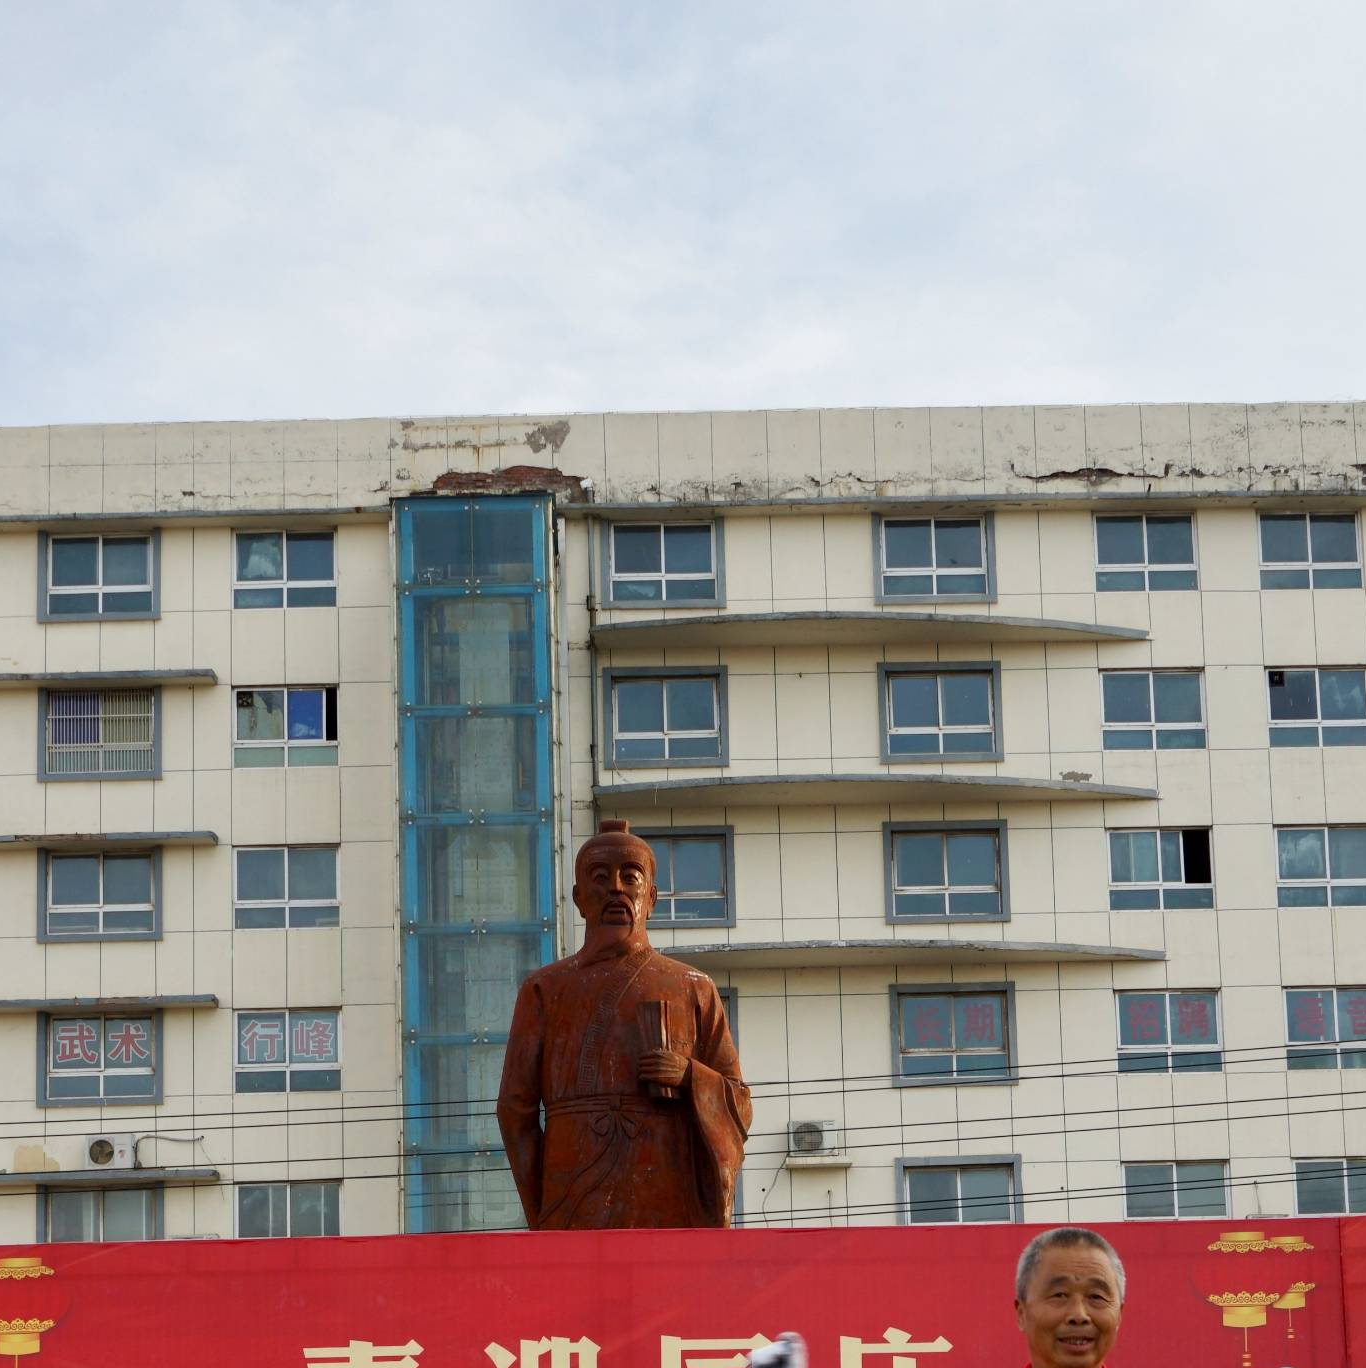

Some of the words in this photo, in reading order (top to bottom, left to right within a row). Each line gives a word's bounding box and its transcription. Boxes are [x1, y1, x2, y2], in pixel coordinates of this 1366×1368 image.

[56, 1022, 149, 1066] 武术
[241, 1019, 334, 1063] 行峰
[911, 1003, 996, 1044] 长期
[1127, 999, 1210, 1040] 招聘
